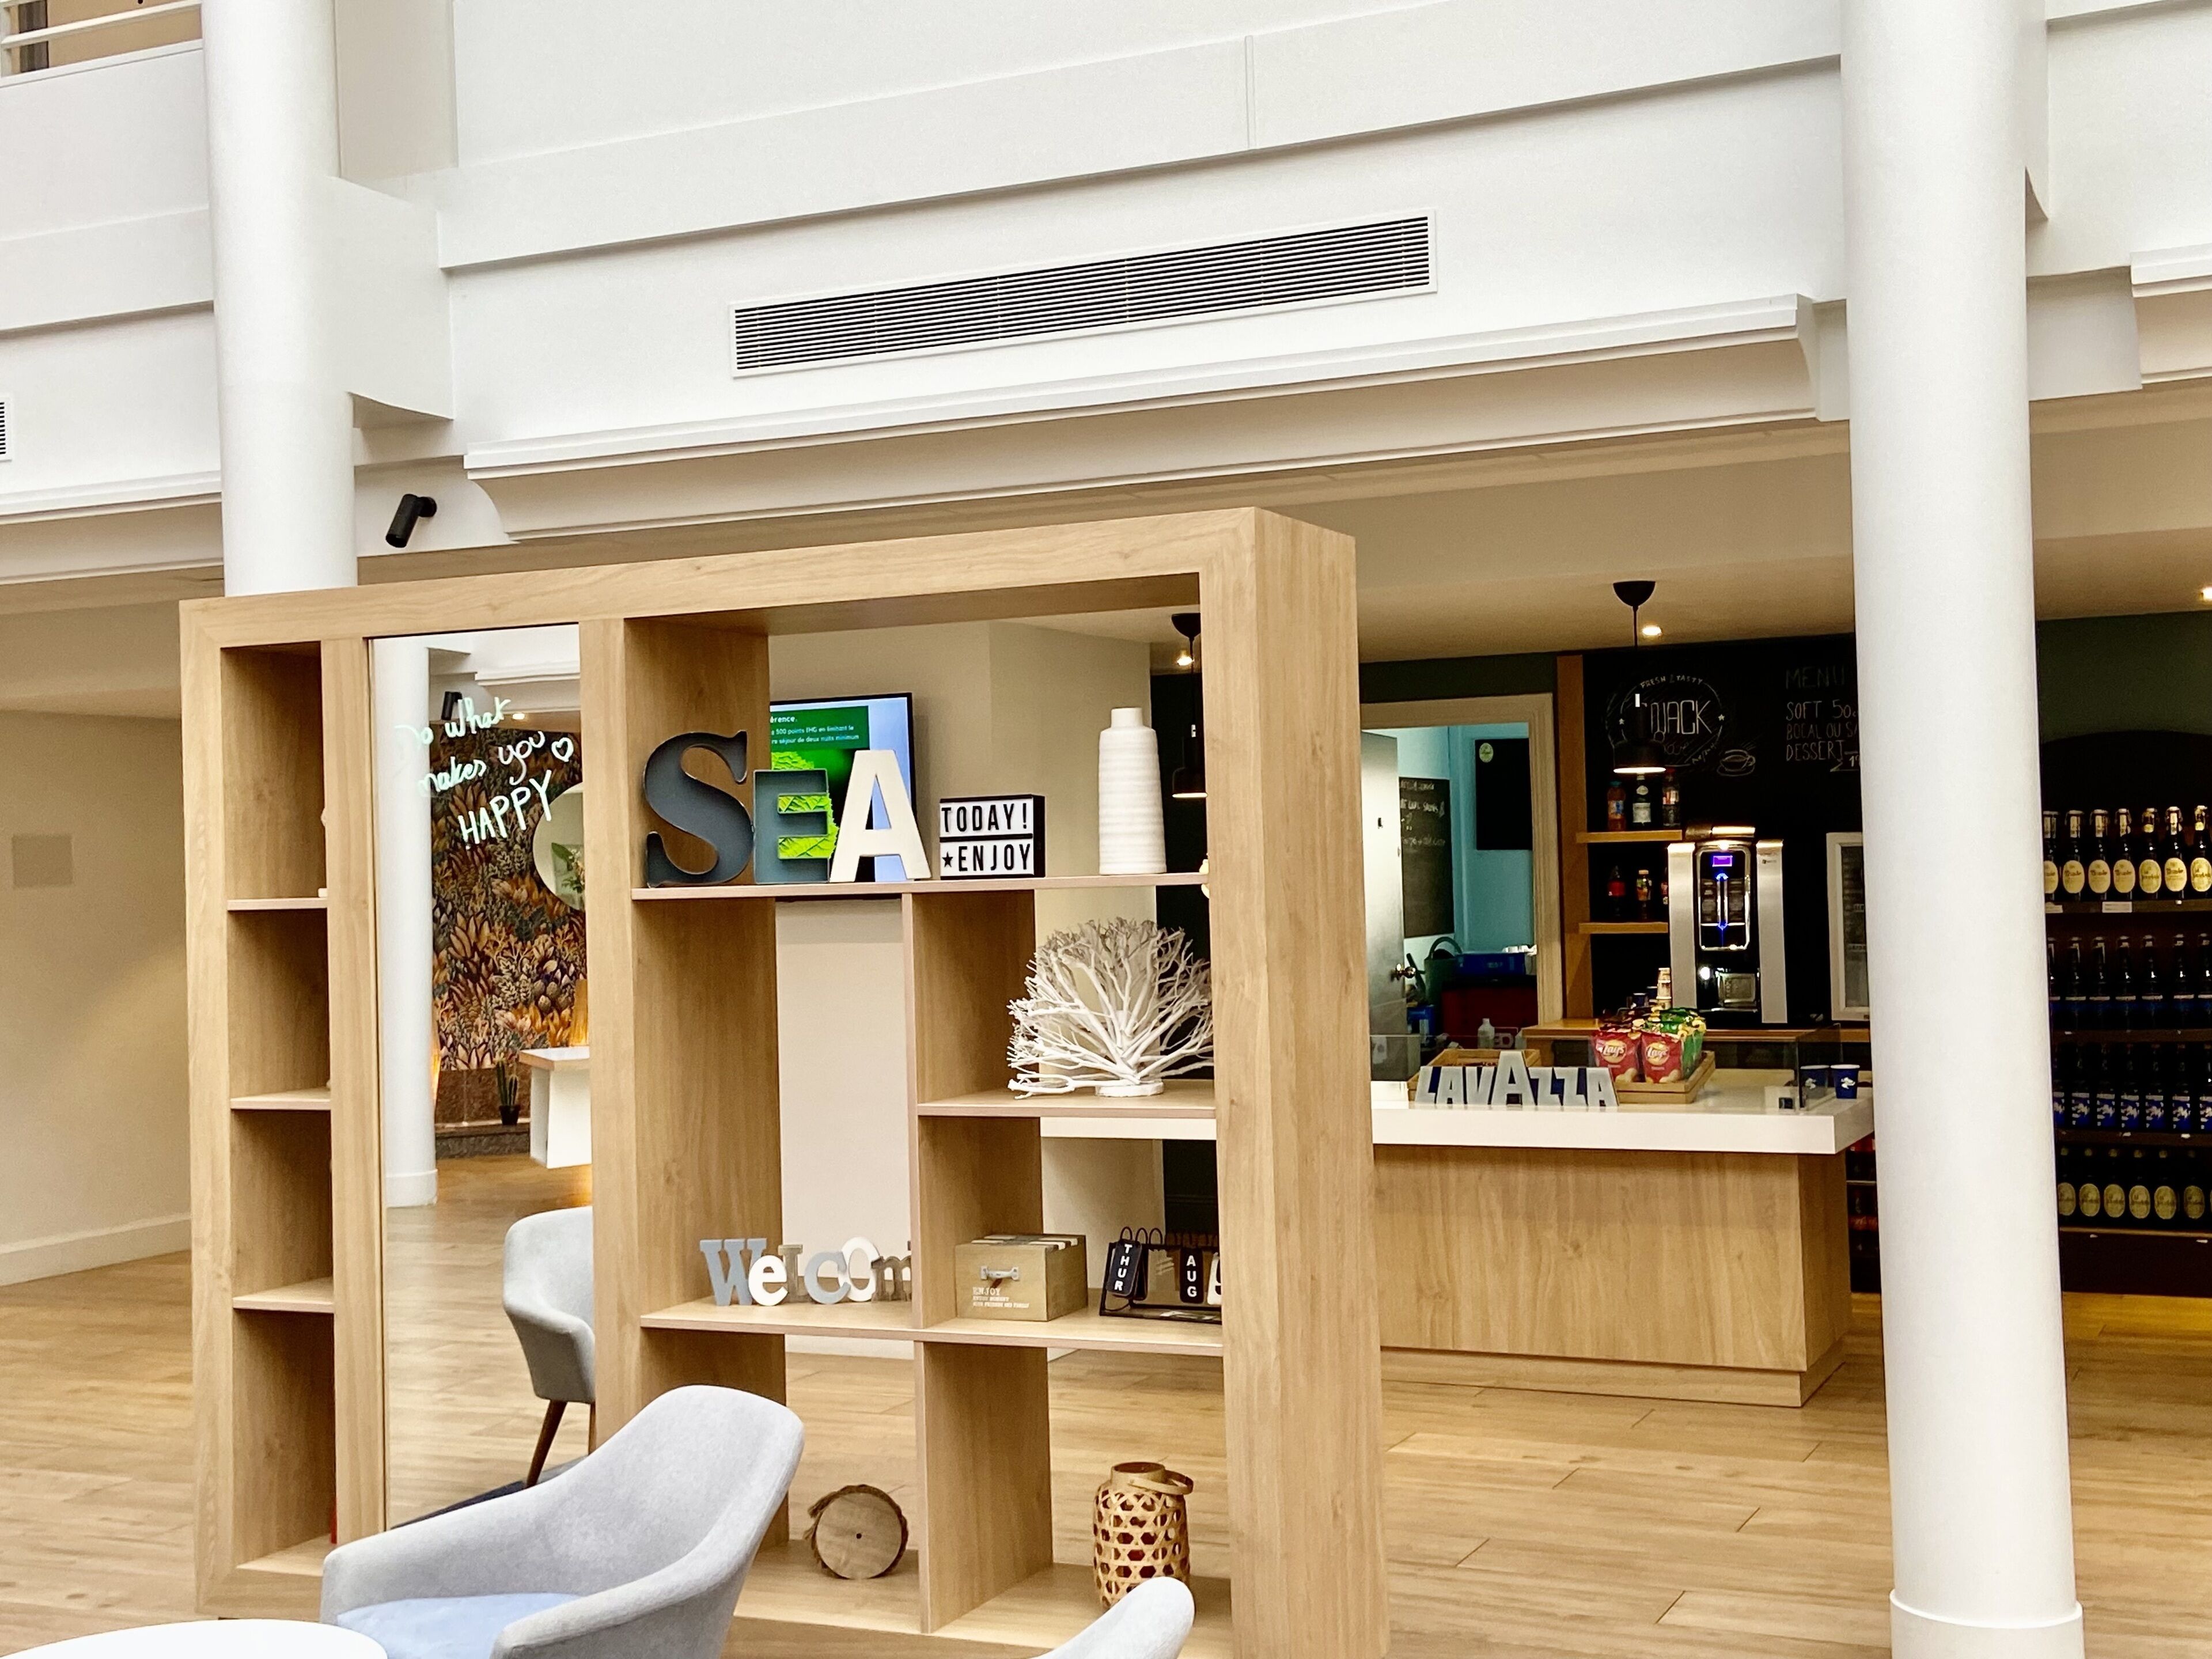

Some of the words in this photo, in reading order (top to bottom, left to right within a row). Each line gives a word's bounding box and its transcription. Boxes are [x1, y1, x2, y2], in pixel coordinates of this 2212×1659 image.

[1641, 676, 1666, 689] FRESH
[1676, 675, 1703, 685] TASTY
[445, 696, 512, 738] what
[1785, 700, 1823, 721] SOFT
[1786, 722, 1823, 741] BOCAL
[1825, 722, 1842, 738] OU
[418, 756, 487, 794] makes
[498, 731, 546, 786] you
[457, 770, 552, 846] HAPPY
[643, 730, 931, 888] SEA
[941, 802, 1027, 833] TODAY!
[958, 843, 1031, 872] ENJOY
[1415, 1050, 1619, 1107] LAVAZZA
[1113, 1243, 1133, 1291] THUR
[1186, 1255, 1197, 1298] AUG
[972, 1287, 1001, 1296] ENJOY
